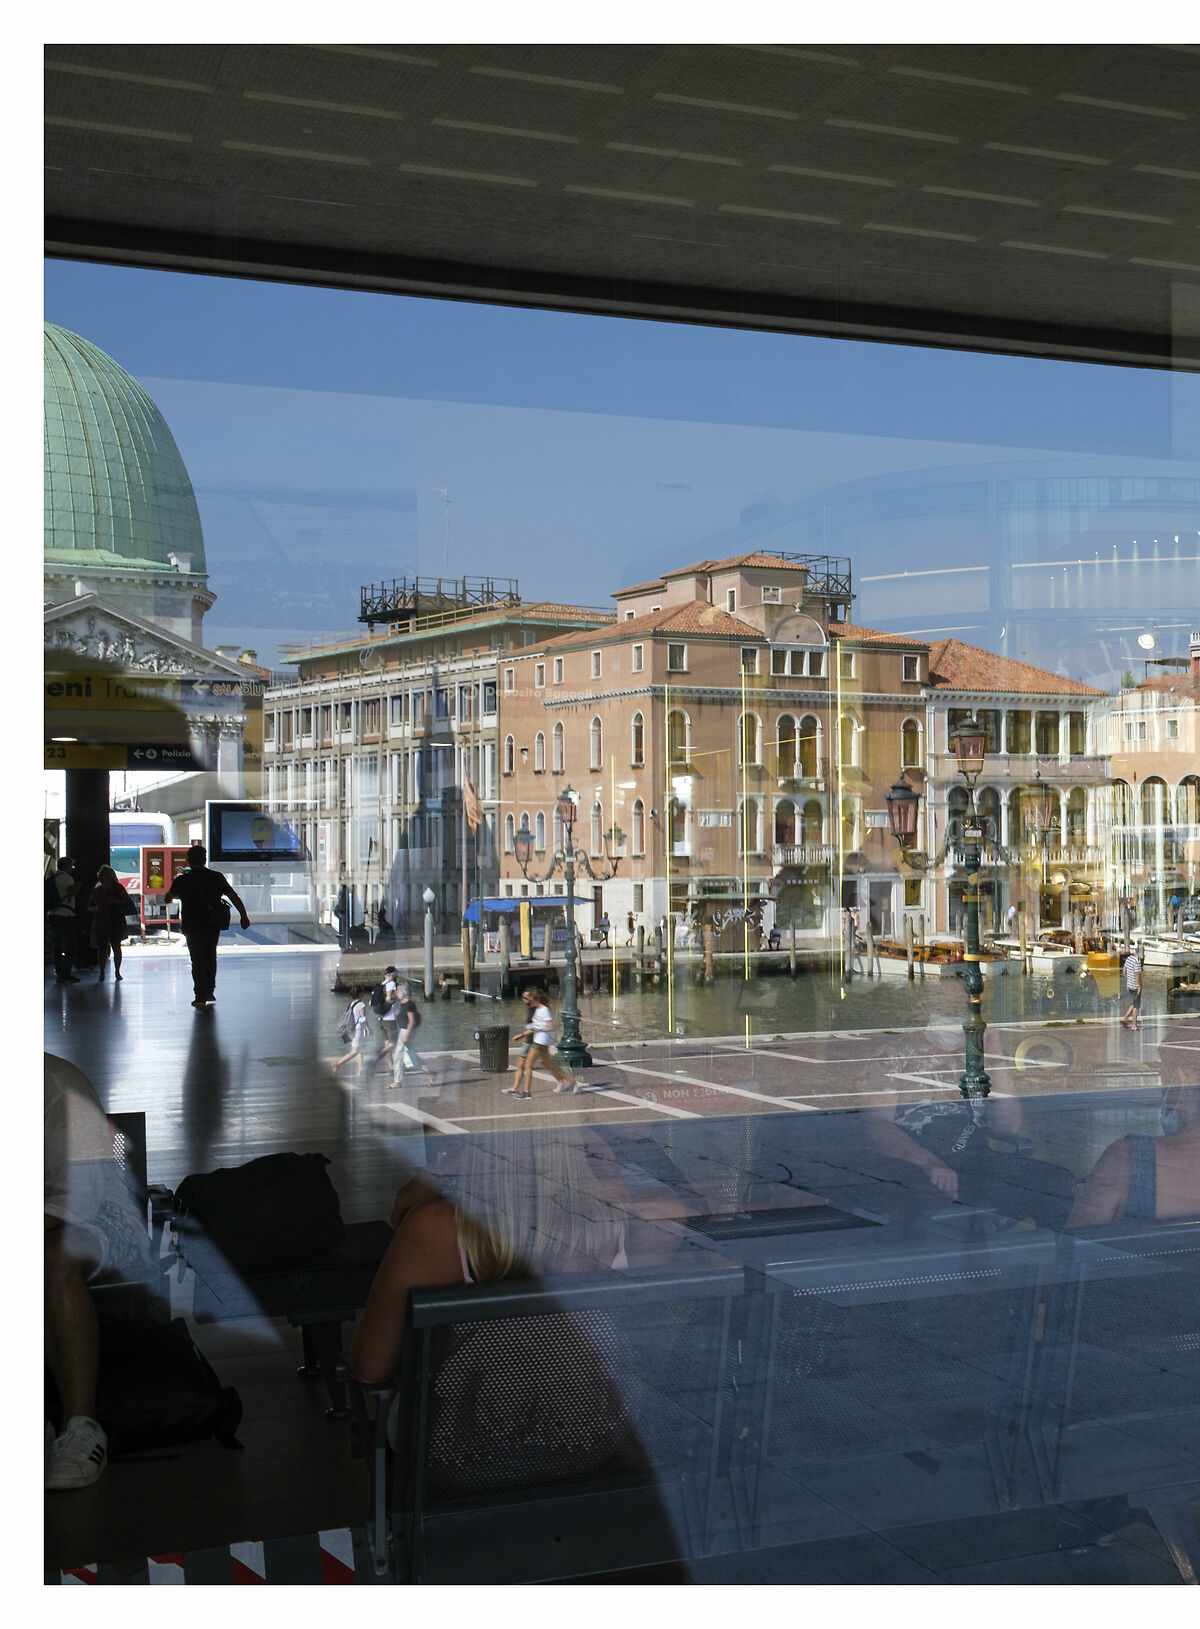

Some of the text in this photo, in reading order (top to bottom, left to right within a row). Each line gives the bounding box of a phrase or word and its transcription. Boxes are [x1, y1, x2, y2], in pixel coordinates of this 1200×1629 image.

[487, 687, 542, 699] Deposito
[47, 747, 66, 759] 23
[161, 749, 192, 758] Polizia
[663, 1088, 690, 1099] NON
